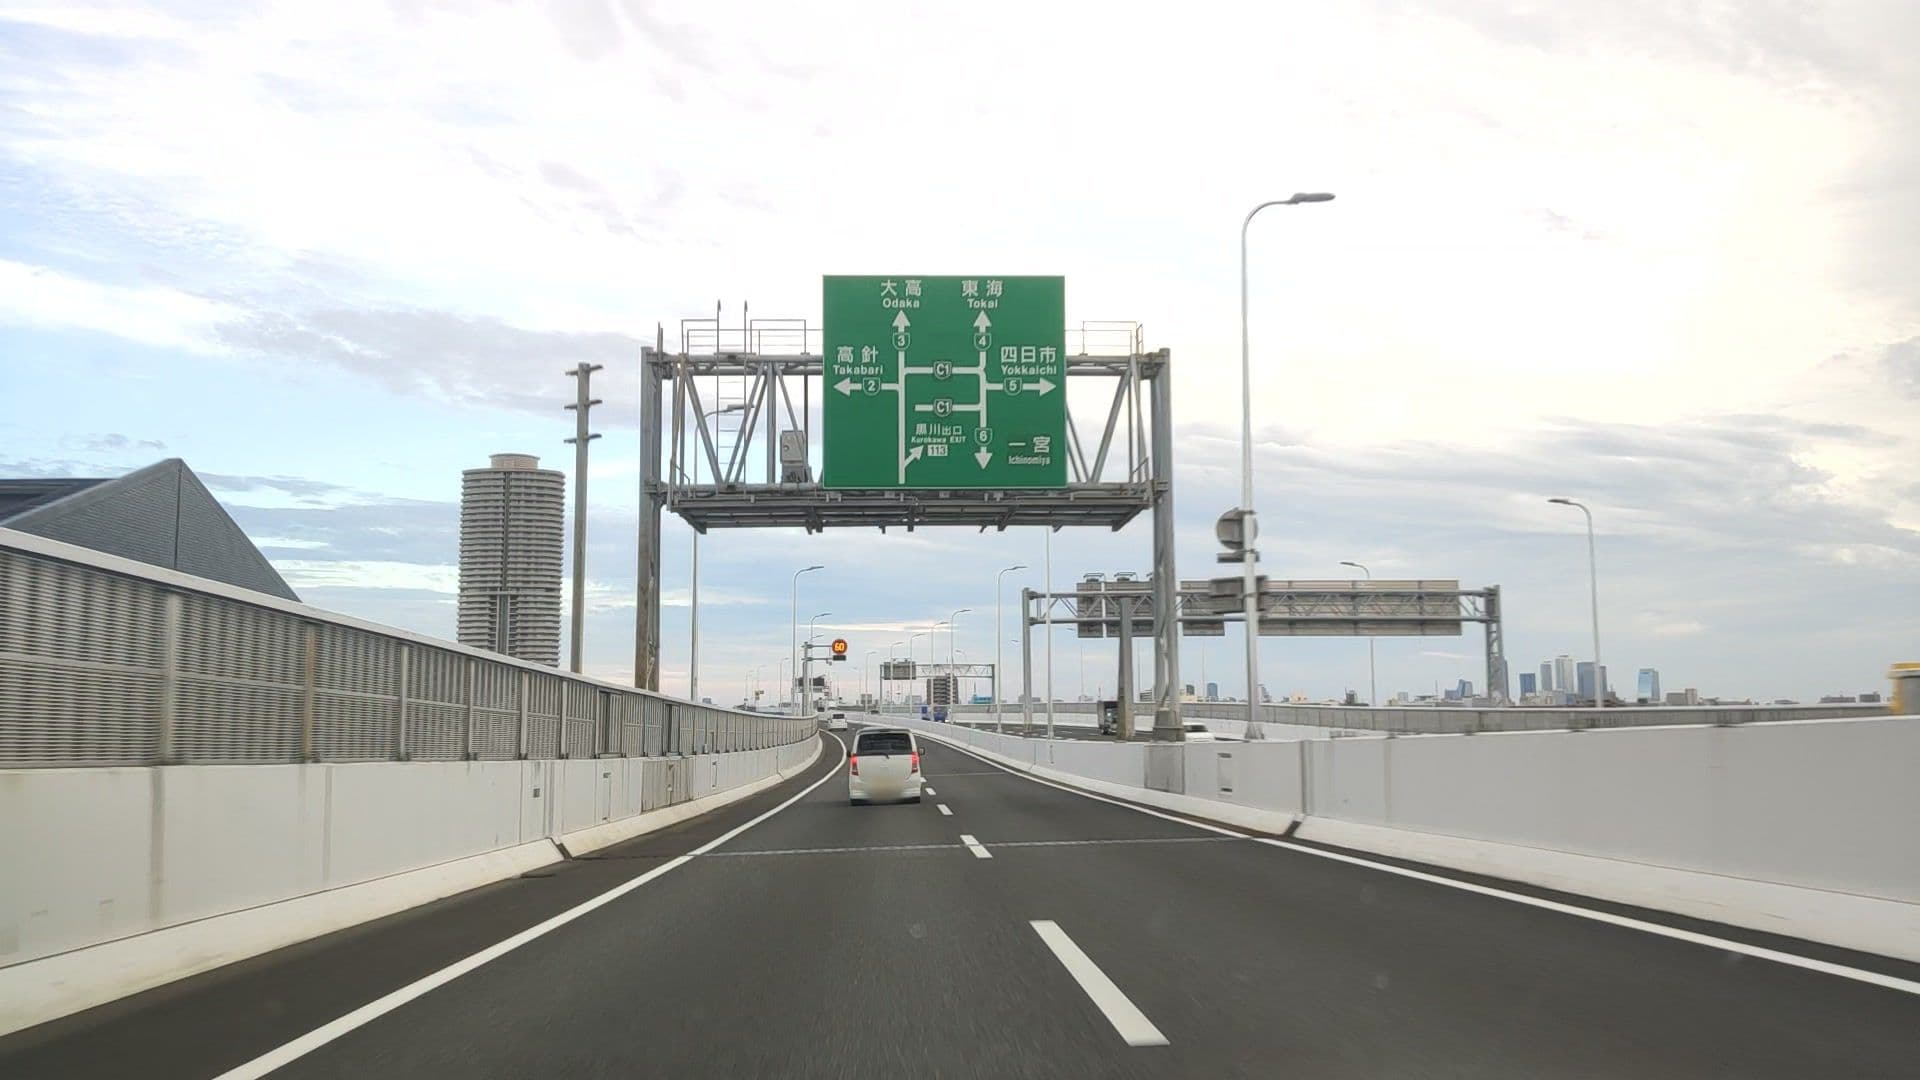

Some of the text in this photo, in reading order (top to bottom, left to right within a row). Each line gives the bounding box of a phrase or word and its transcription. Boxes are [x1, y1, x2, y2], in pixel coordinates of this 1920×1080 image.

[880, 279, 922, 297] 大高
[961, 279, 1003, 297] 東海
[882, 297, 920, 309] Odaka
[967, 297, 998, 309] Tokai
[836, 346, 879, 363] 高針
[1001, 346, 1057, 363] 四日市
[833, 365, 883, 375] Takabari
[935, 364, 950, 376] C1
[1001, 365, 1057, 376] Yokkaichi
[867, 380, 877, 391] 2
[935, 401, 950, 413] C1
[915, 423, 963, 436] 黒川出口
[950, 436, 966, 444] EXIT
[1008, 436, 1051, 453] 一宮
[930, 446, 946, 456] 113
[1008, 455, 1051, 466] Ichinomiya
